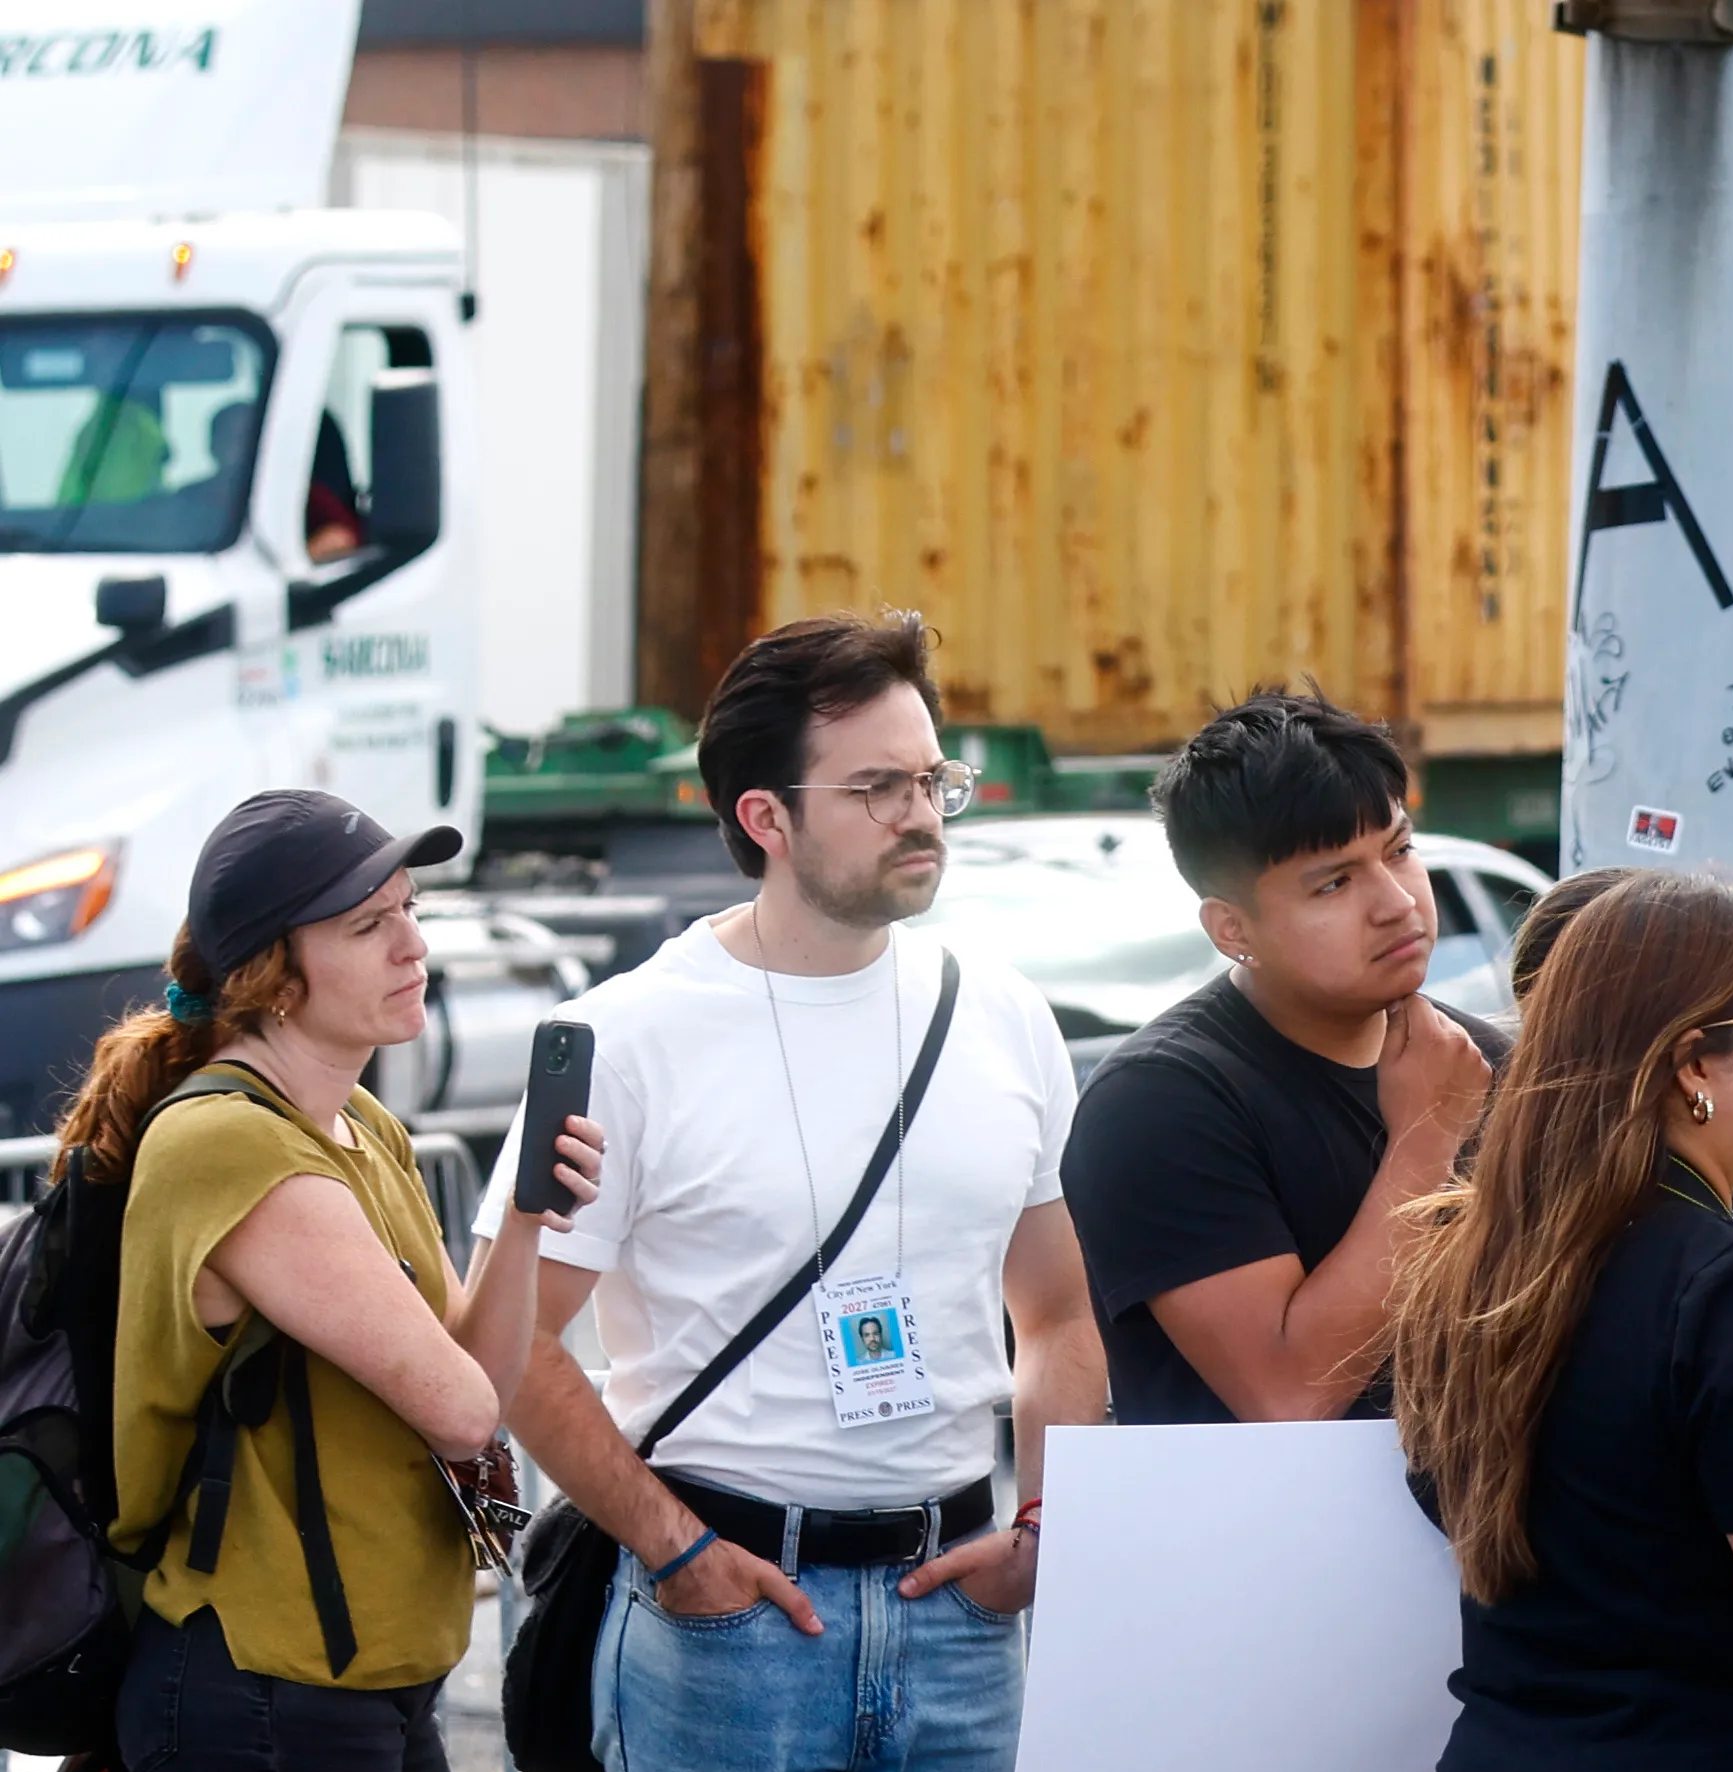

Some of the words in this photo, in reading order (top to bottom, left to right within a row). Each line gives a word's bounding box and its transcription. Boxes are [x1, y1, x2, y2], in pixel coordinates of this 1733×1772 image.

[827, 1289, 845, 1300] City
[846, 1286, 855, 1296] of
[856, 1284, 874, 1293] New
[875, 1280, 897, 1290] York
[841, 1300, 868, 1314] 2027
[901, 1296, 925, 1381] PRESS
[821, 1311, 845, 1395] PRESS
[840, 1408, 875, 1423] PRESS
[896, 1398, 931, 1412] PRESS
